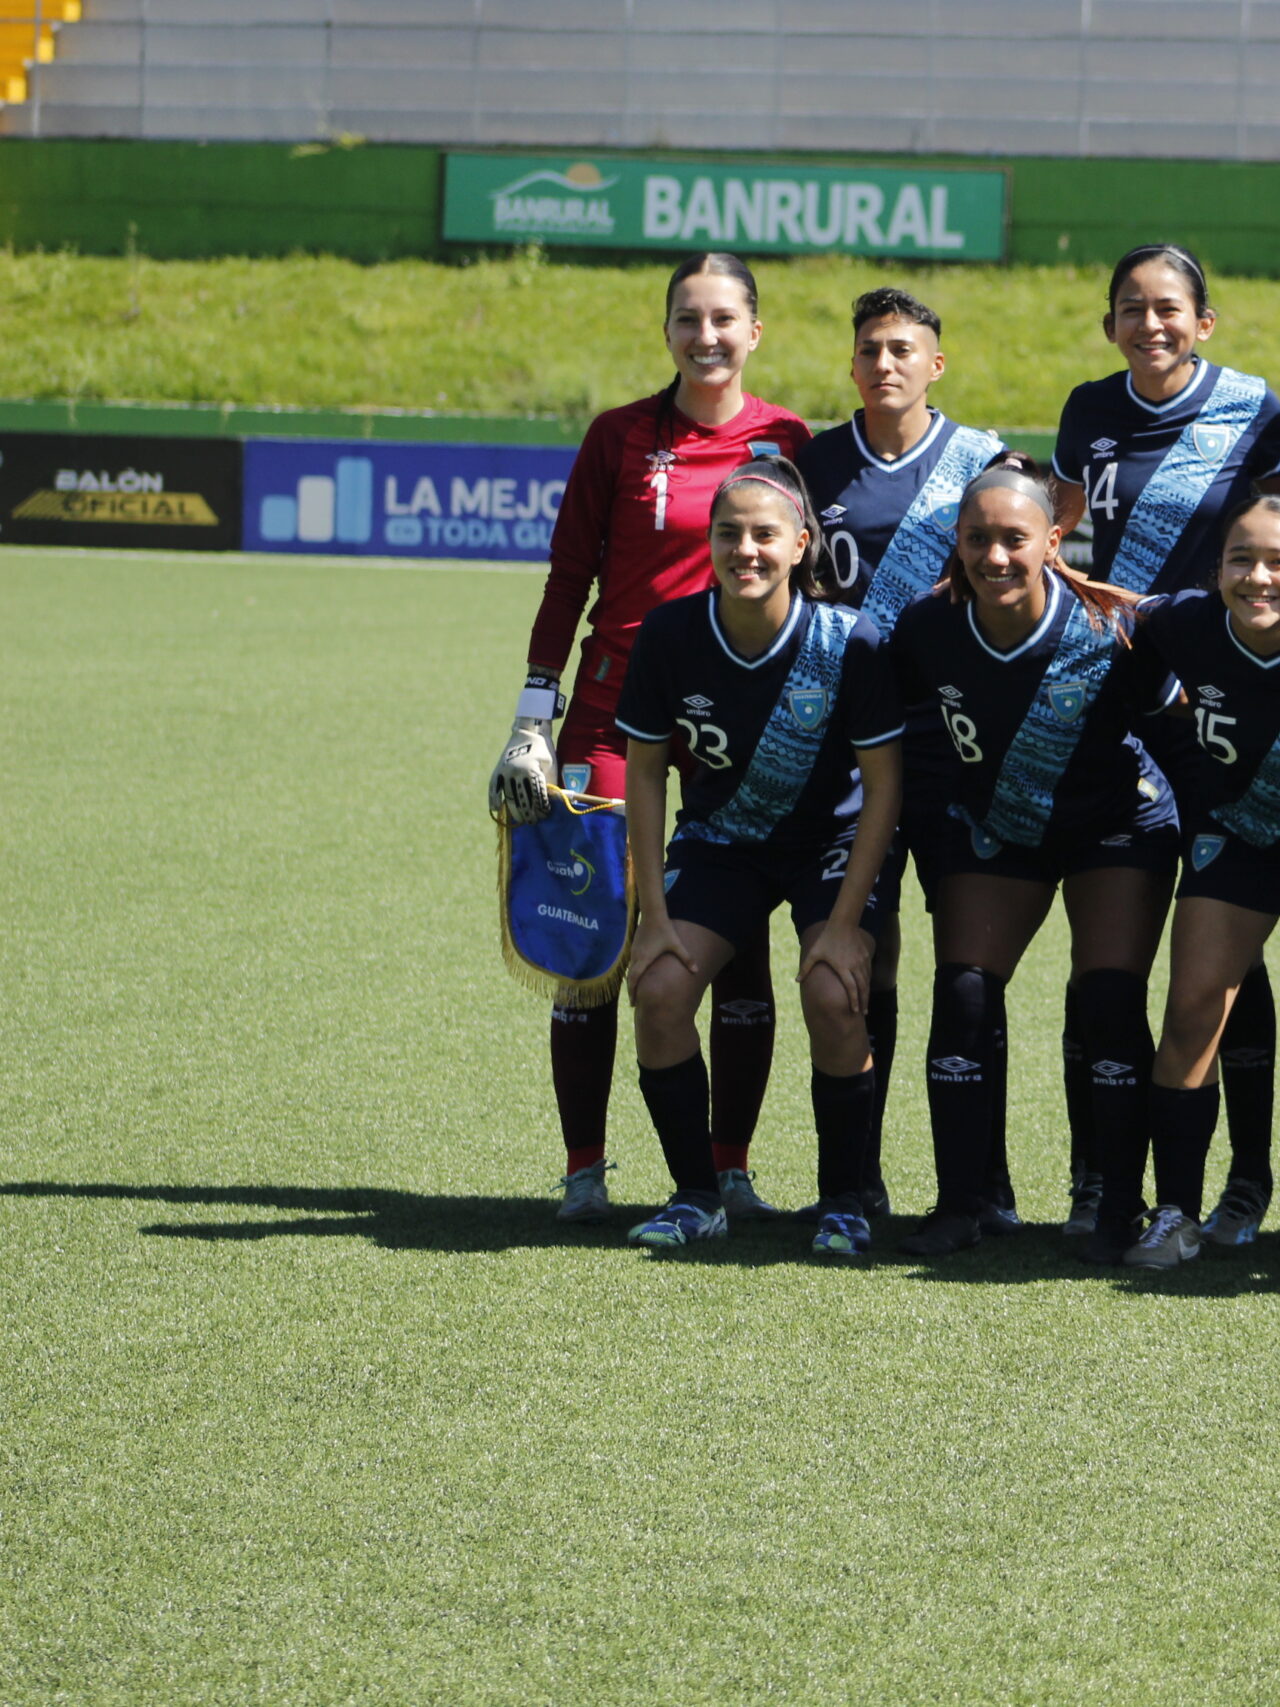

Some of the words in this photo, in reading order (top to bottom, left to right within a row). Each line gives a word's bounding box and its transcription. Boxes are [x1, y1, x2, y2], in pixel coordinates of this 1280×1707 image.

[643, 176, 963, 248] BANRURAL
[55, 467, 163, 493] BALÓN
[385, 475, 442, 516] LA
[651, 472, 669, 531] 1
[427, 518, 508, 548] TODA
[1194, 707, 1238, 765] 15
[537, 903, 599, 931] GUATEMALA
